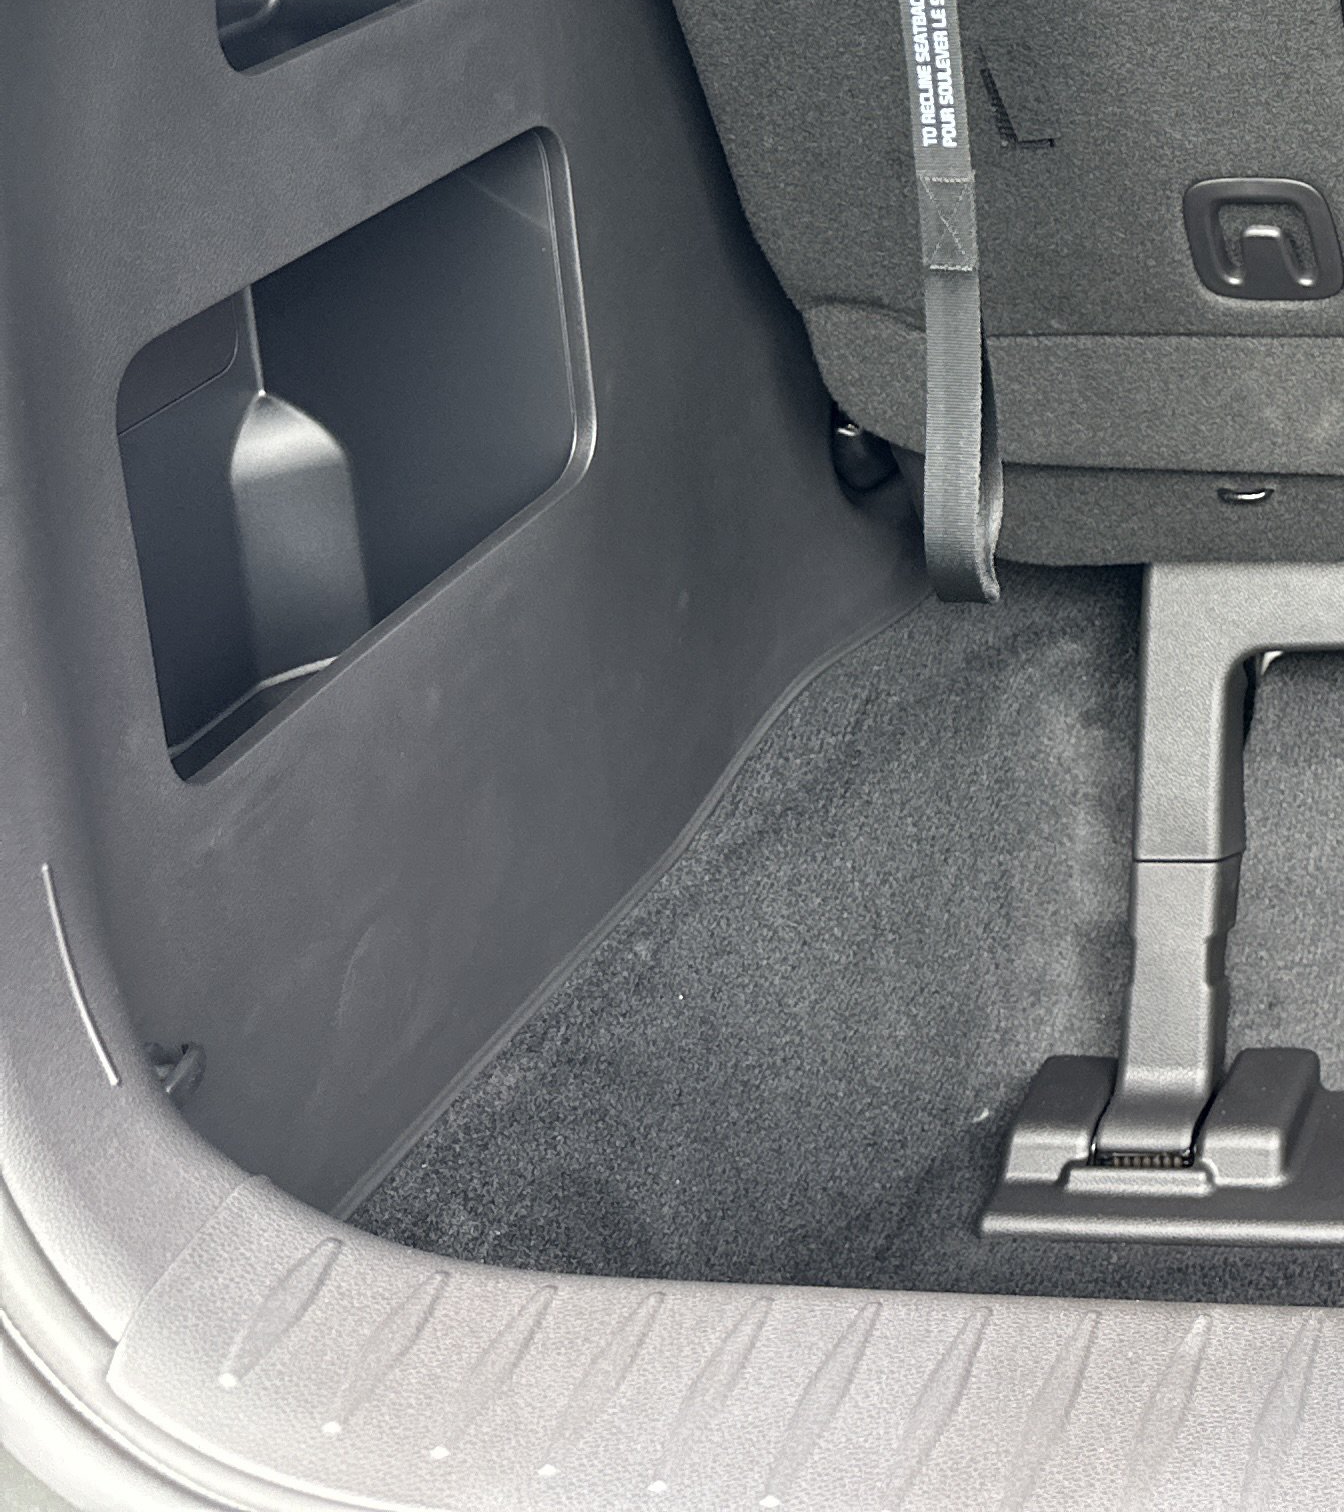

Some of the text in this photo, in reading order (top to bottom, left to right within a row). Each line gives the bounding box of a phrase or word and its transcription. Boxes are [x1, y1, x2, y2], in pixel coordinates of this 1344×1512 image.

[931, 8, 946, 28] LE
[933, 30, 954, 105] SOULEVER
[916, 65, 936, 124] RECLINE
[922, 126, 937, 147] TO
[940, 108, 957, 148] POUR
